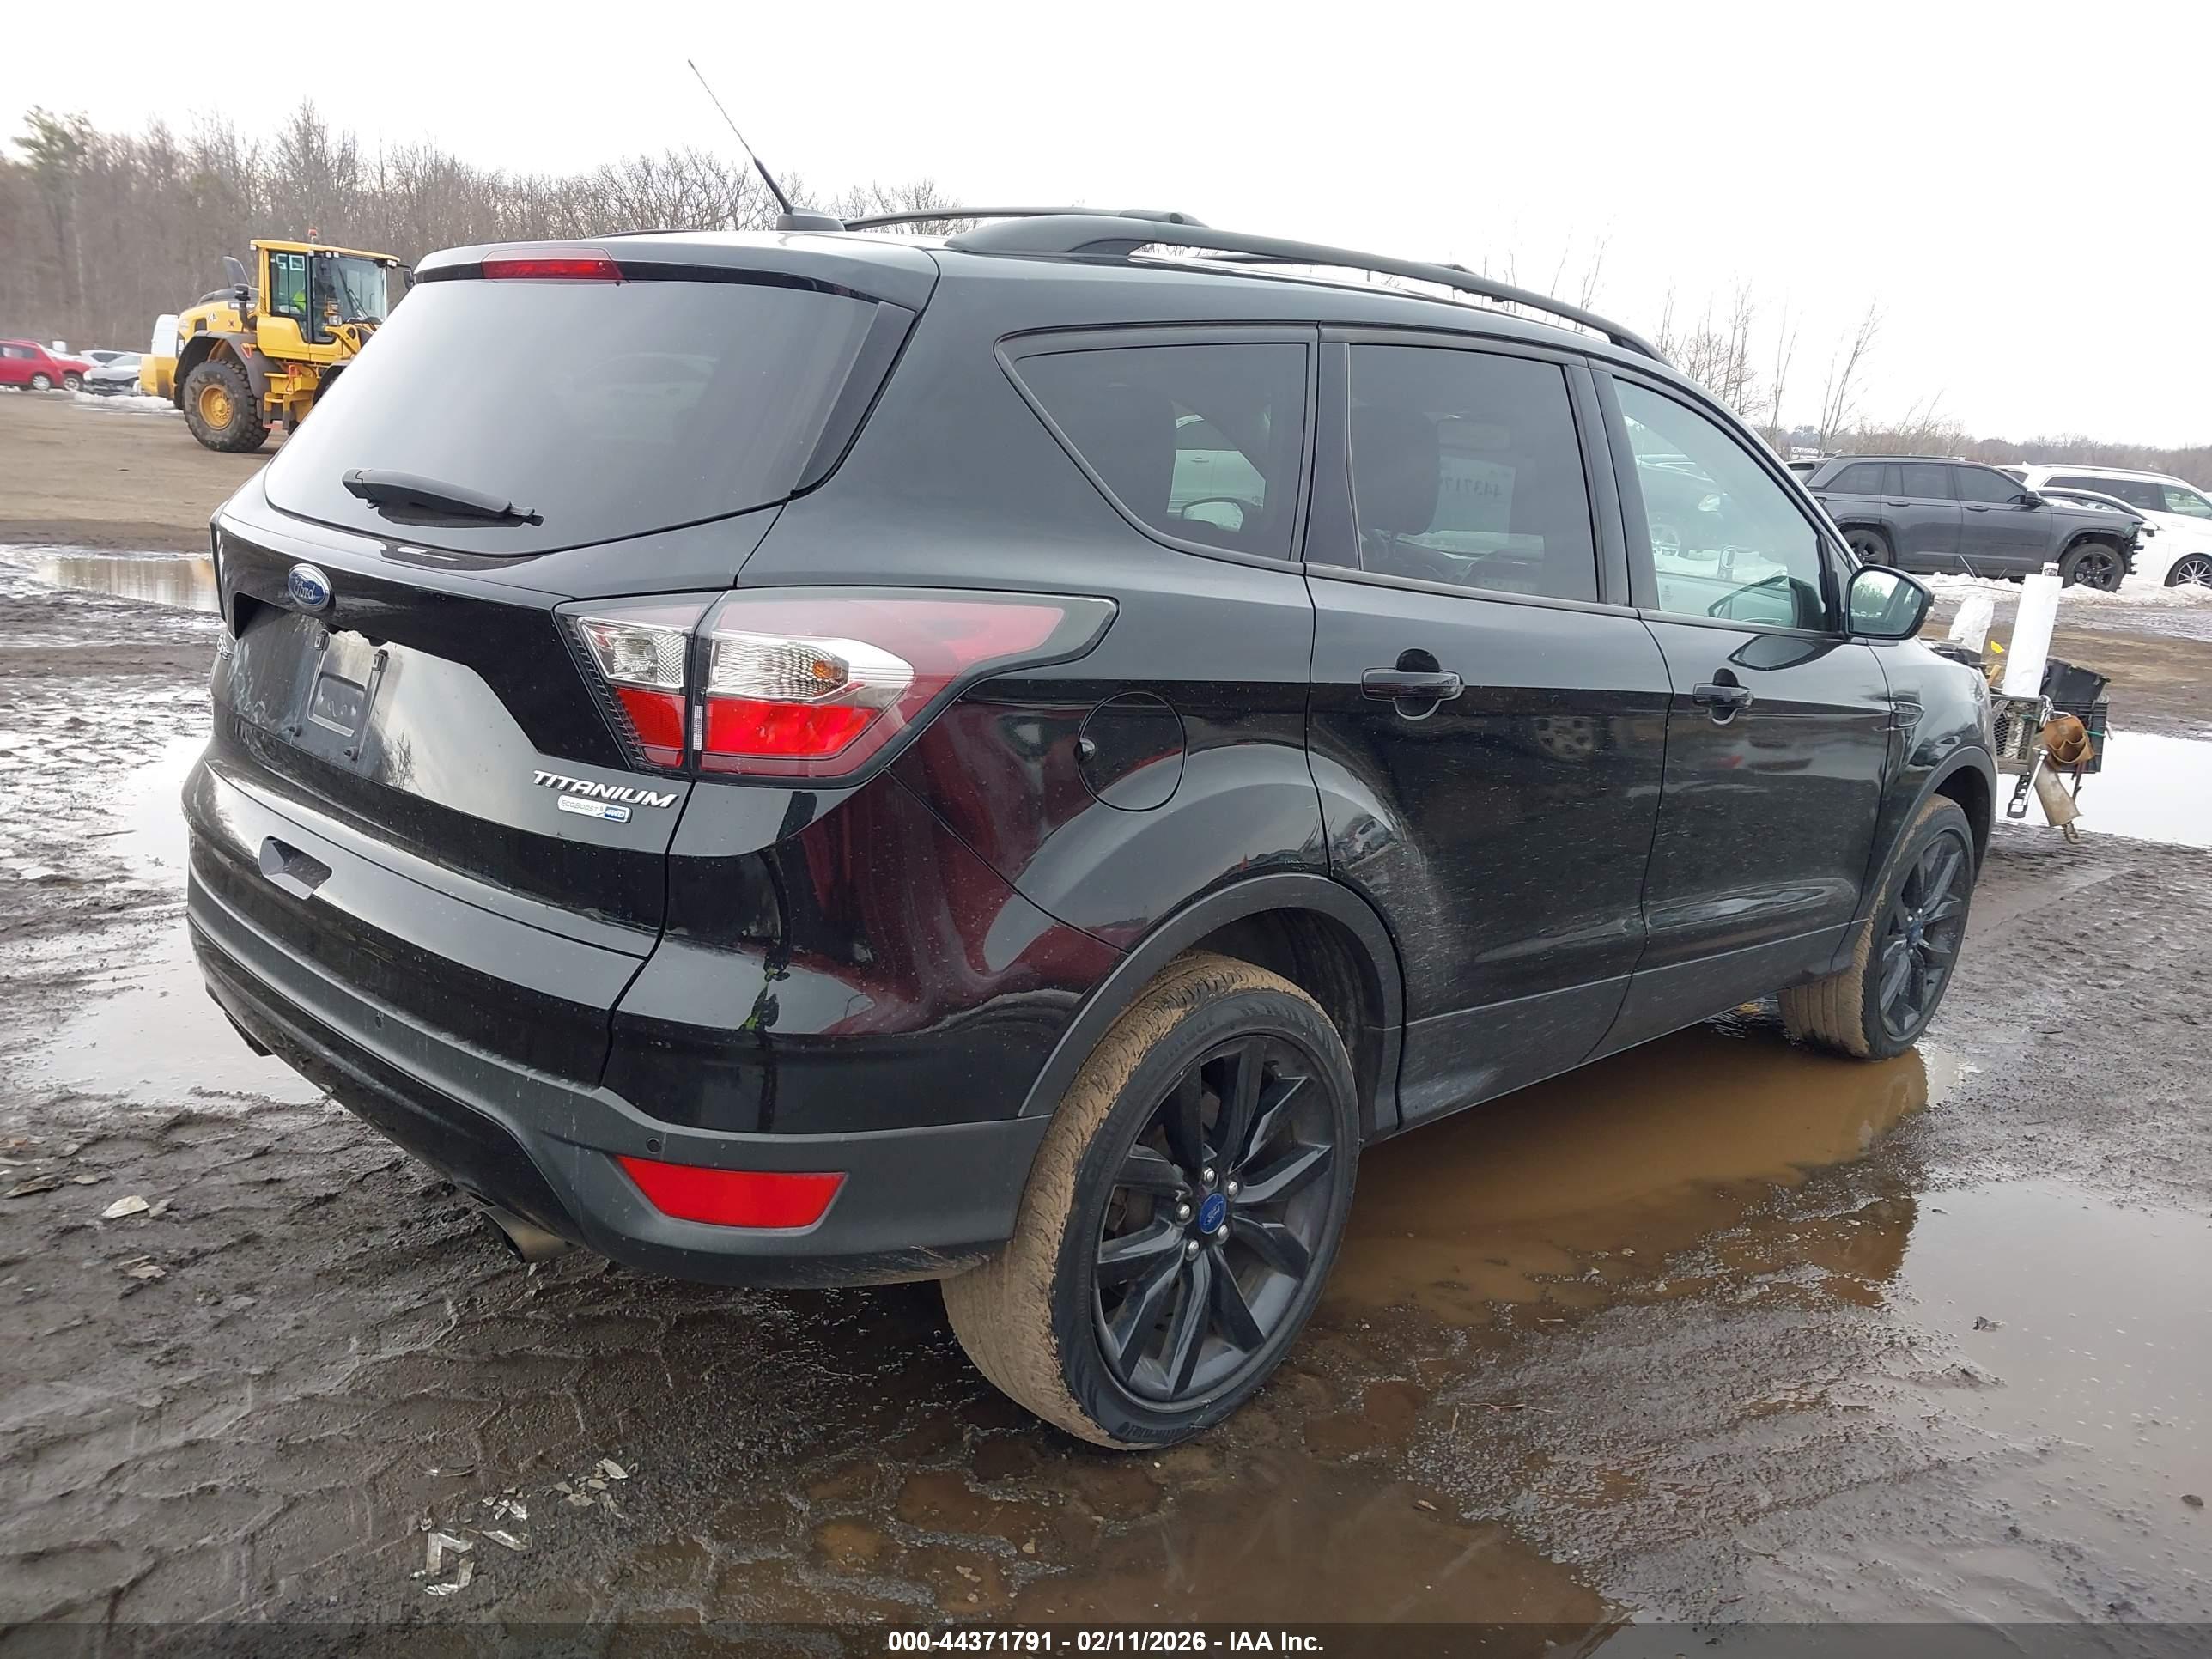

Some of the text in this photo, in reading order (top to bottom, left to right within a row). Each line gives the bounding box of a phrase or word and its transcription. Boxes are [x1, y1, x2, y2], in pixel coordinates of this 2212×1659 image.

[293, 578, 317, 601] Ford
[533, 769, 679, 808] TITANIUM
[605, 807, 625, 818] 4WD
